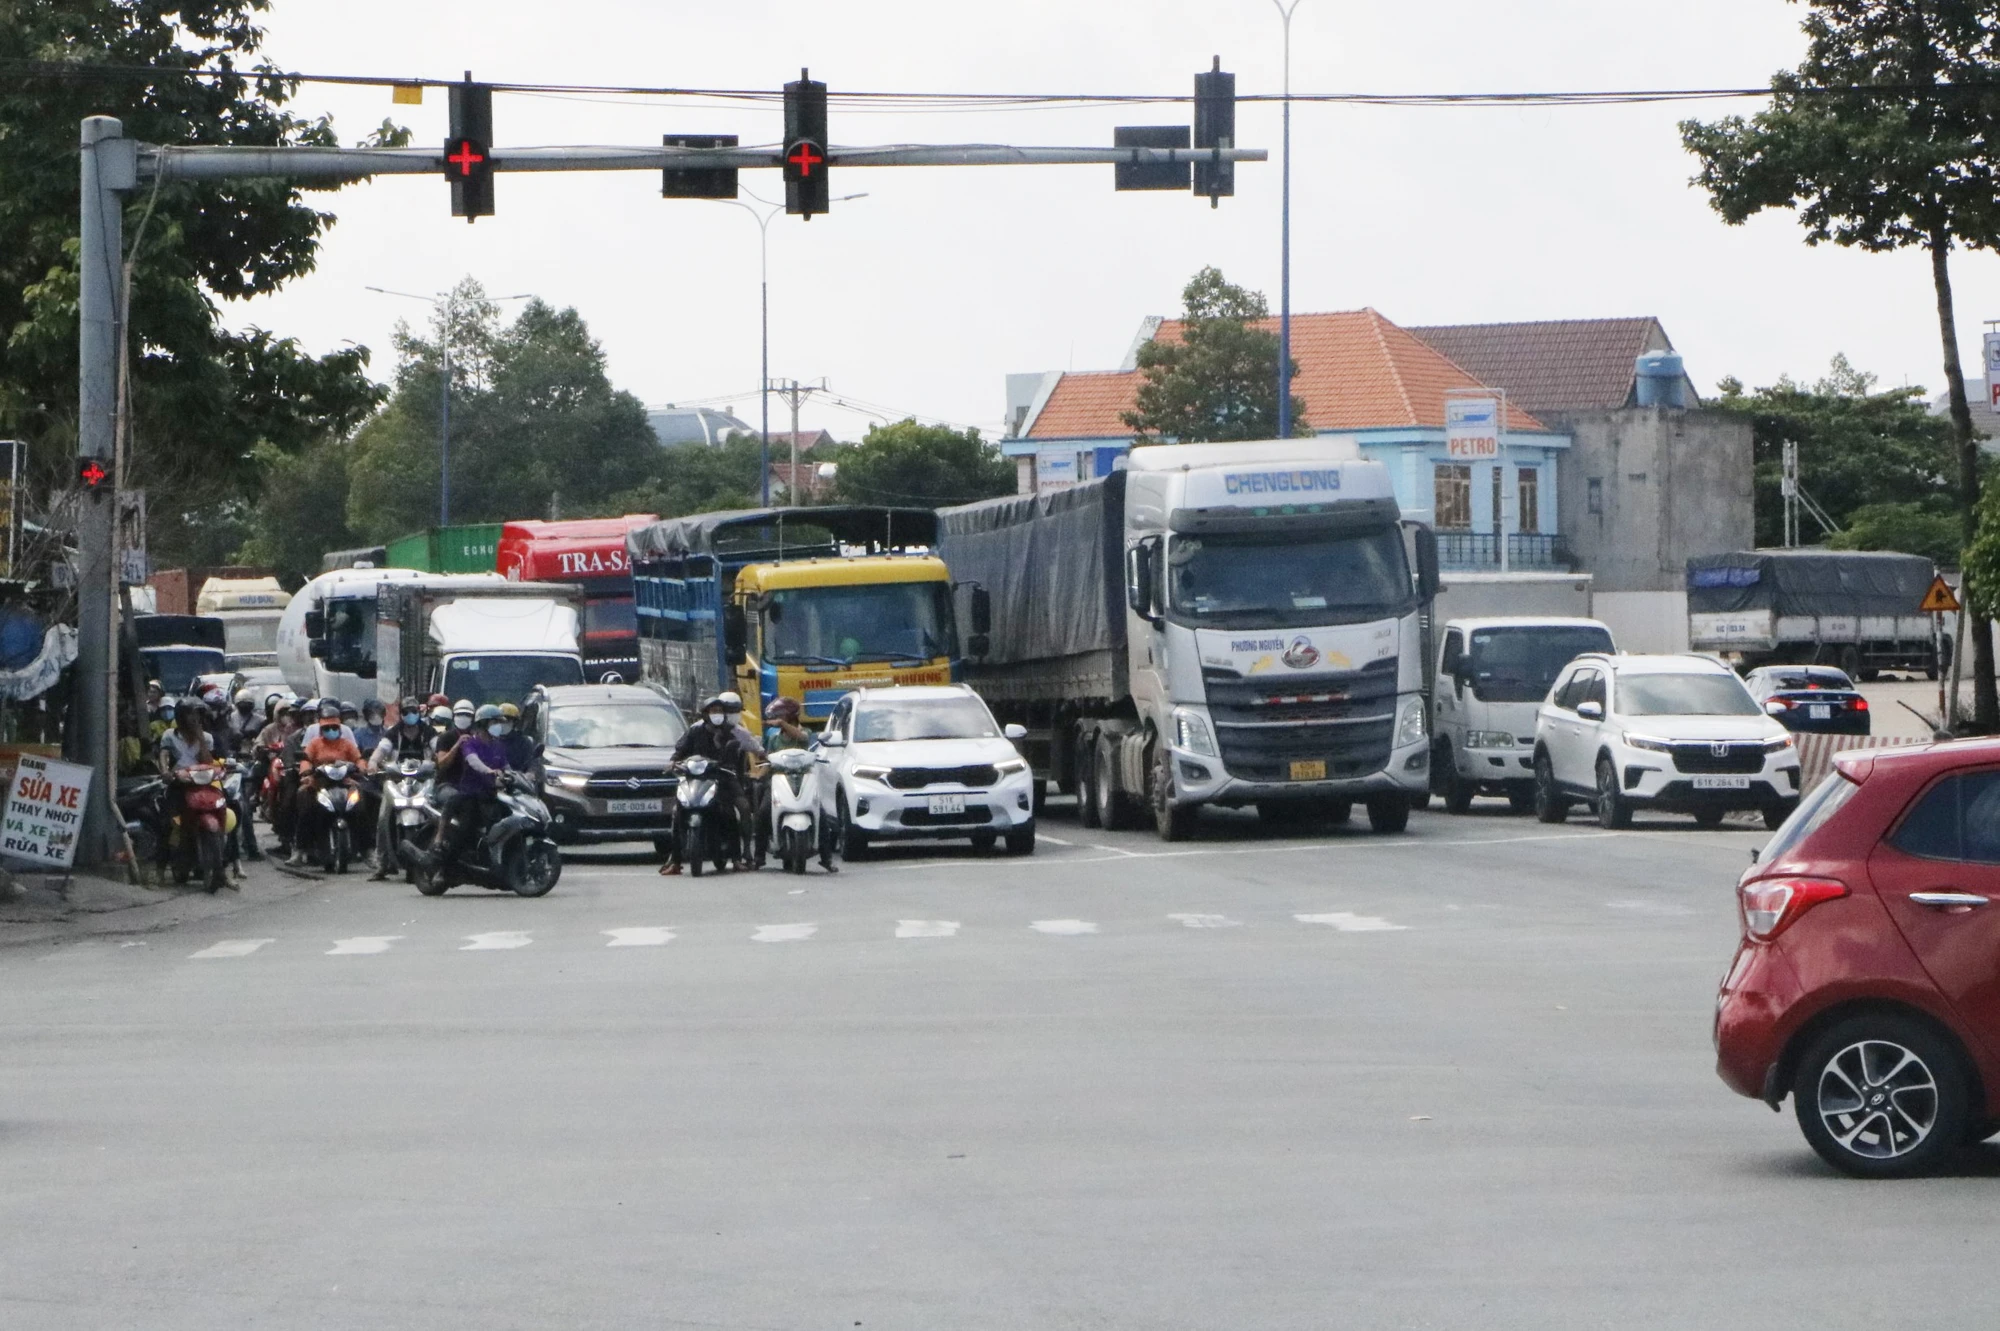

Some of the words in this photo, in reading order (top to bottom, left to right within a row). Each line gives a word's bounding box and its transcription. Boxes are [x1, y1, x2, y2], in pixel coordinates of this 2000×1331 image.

[1450, 437, 1496, 455] PETRO
[1224, 470, 1341, 494] CHENGLONG
[799, 678, 832, 690] MINH
[21, 758, 47, 771] GIANG
[18, 772, 52, 803] SỬA
[56, 785, 81, 809] XE
[11, 801, 42, 817] THAY
[44, 808, 79, 825] NHỚT
[6, 817, 24, 833] VÁ
[29, 823, 48, 837] XE
[5, 836, 39, 854] RỬA
[44, 846, 66, 860] XE
